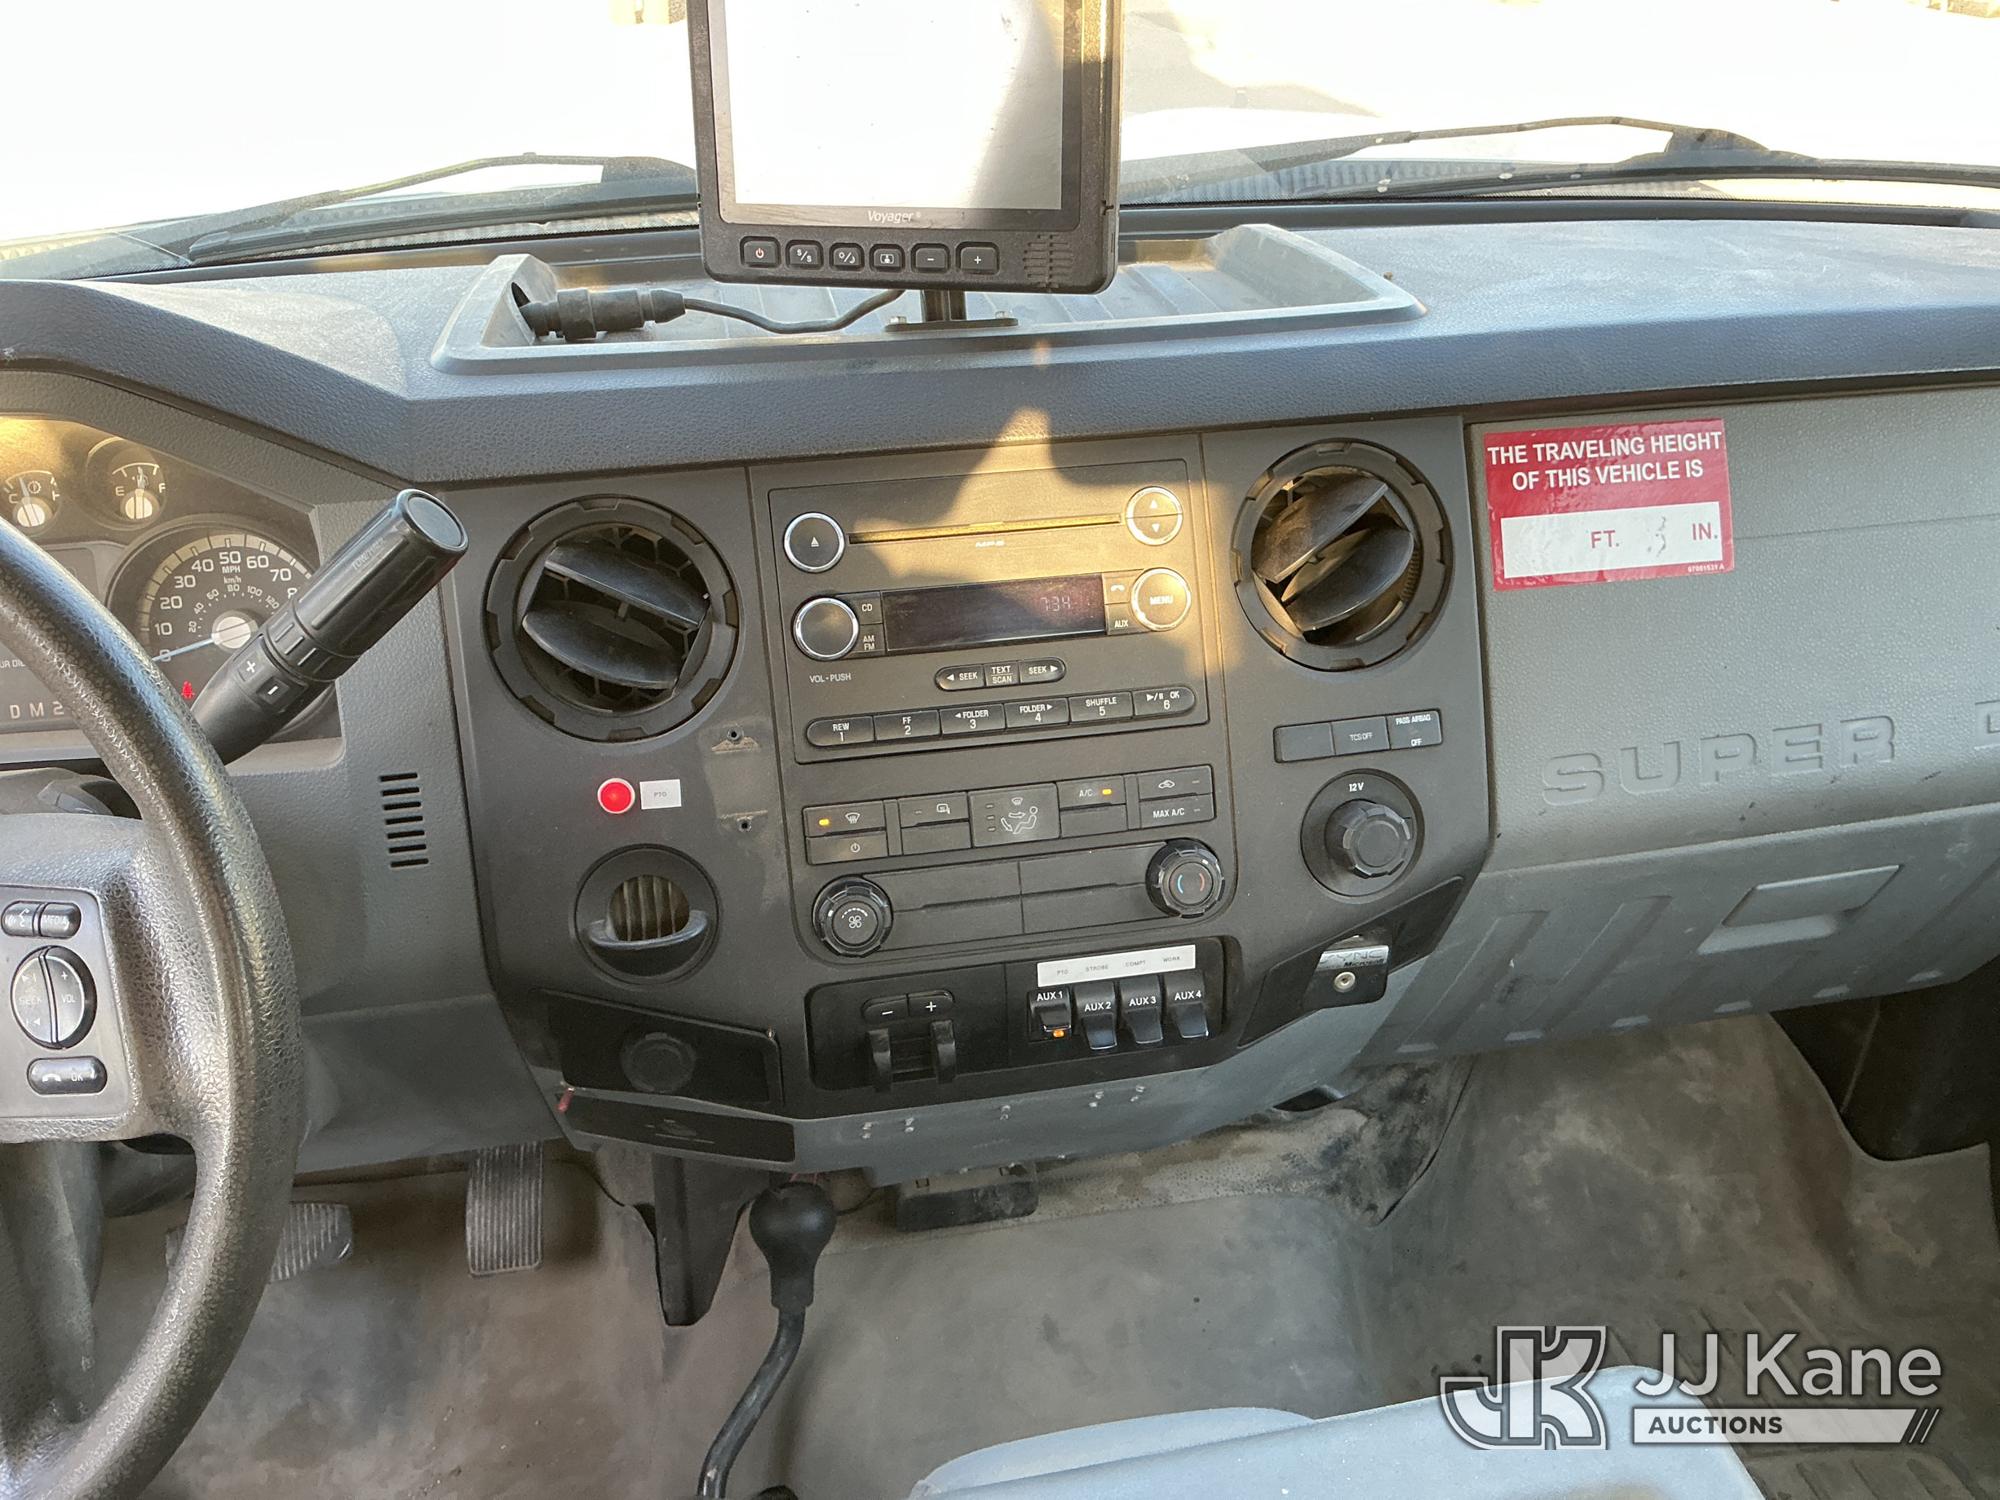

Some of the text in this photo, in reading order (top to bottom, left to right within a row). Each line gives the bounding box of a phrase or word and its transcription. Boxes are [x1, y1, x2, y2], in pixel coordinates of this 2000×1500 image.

[867, 210, 914, 224] Voyager
[1487, 431, 1722, 465] THE TRAVELING HEIGHT
[1512, 459, 1704, 491] OF THIS VEHICLE IS
[115, 486, 125, 496] E
[158, 483, 166, 493] F
[1591, 522, 1718, 549] FT. IN.
[219, 551, 242, 565] 50
[246, 555, 269, 569] 60
[191, 559, 214, 572] 40
[270, 568, 292, 582] 70
[174, 575, 196, 588] 30
[223, 577, 242, 585] km/h
[247, 585, 263, 597] 100
[160, 595, 183, 609] 20
[861, 604, 873, 612] CD
[155, 622, 173, 635] 10
[1114, 619, 1129, 628] AUX
[864, 643, 875, 651] FM
[991, 666, 1011, 674] TEXT
[1028, 665, 1047, 675] SEEK
[959, 672, 978, 681] SEEK
[992, 675, 1012, 684] SCAN
[1169, 690, 1180, 699] OK
[1085, 696, 1117, 707] SHUFFLE
[1163, 699, 1171, 710] 6
[9, 701, 65, 719] D M 2
[1019, 703, 1046, 713] FOLDER
[1099, 706, 1106, 716] 5
[962, 709, 989, 719] FOLDER
[1035, 712, 1042, 722] 4
[902, 717, 912, 725] FF
[969, 719, 977, 729] 3
[832, 723, 850, 731] REW
[904, 726, 912, 735] 2
[839, 732, 845, 742] 1
[1410, 738, 1422, 747] OFF
[1542, 715, 1895, 807] SUPER
[1079, 788, 1093, 797] A/C
[1171, 808, 1185, 816] A/C
[61, 994, 76, 1003] VOL
[1036, 992, 1057, 1002] AUX
[1174, 992, 1194, 1001] AUX
[1084, 1002, 1105, 1012] AUX
[1129, 998, 1149, 1007] AUX
